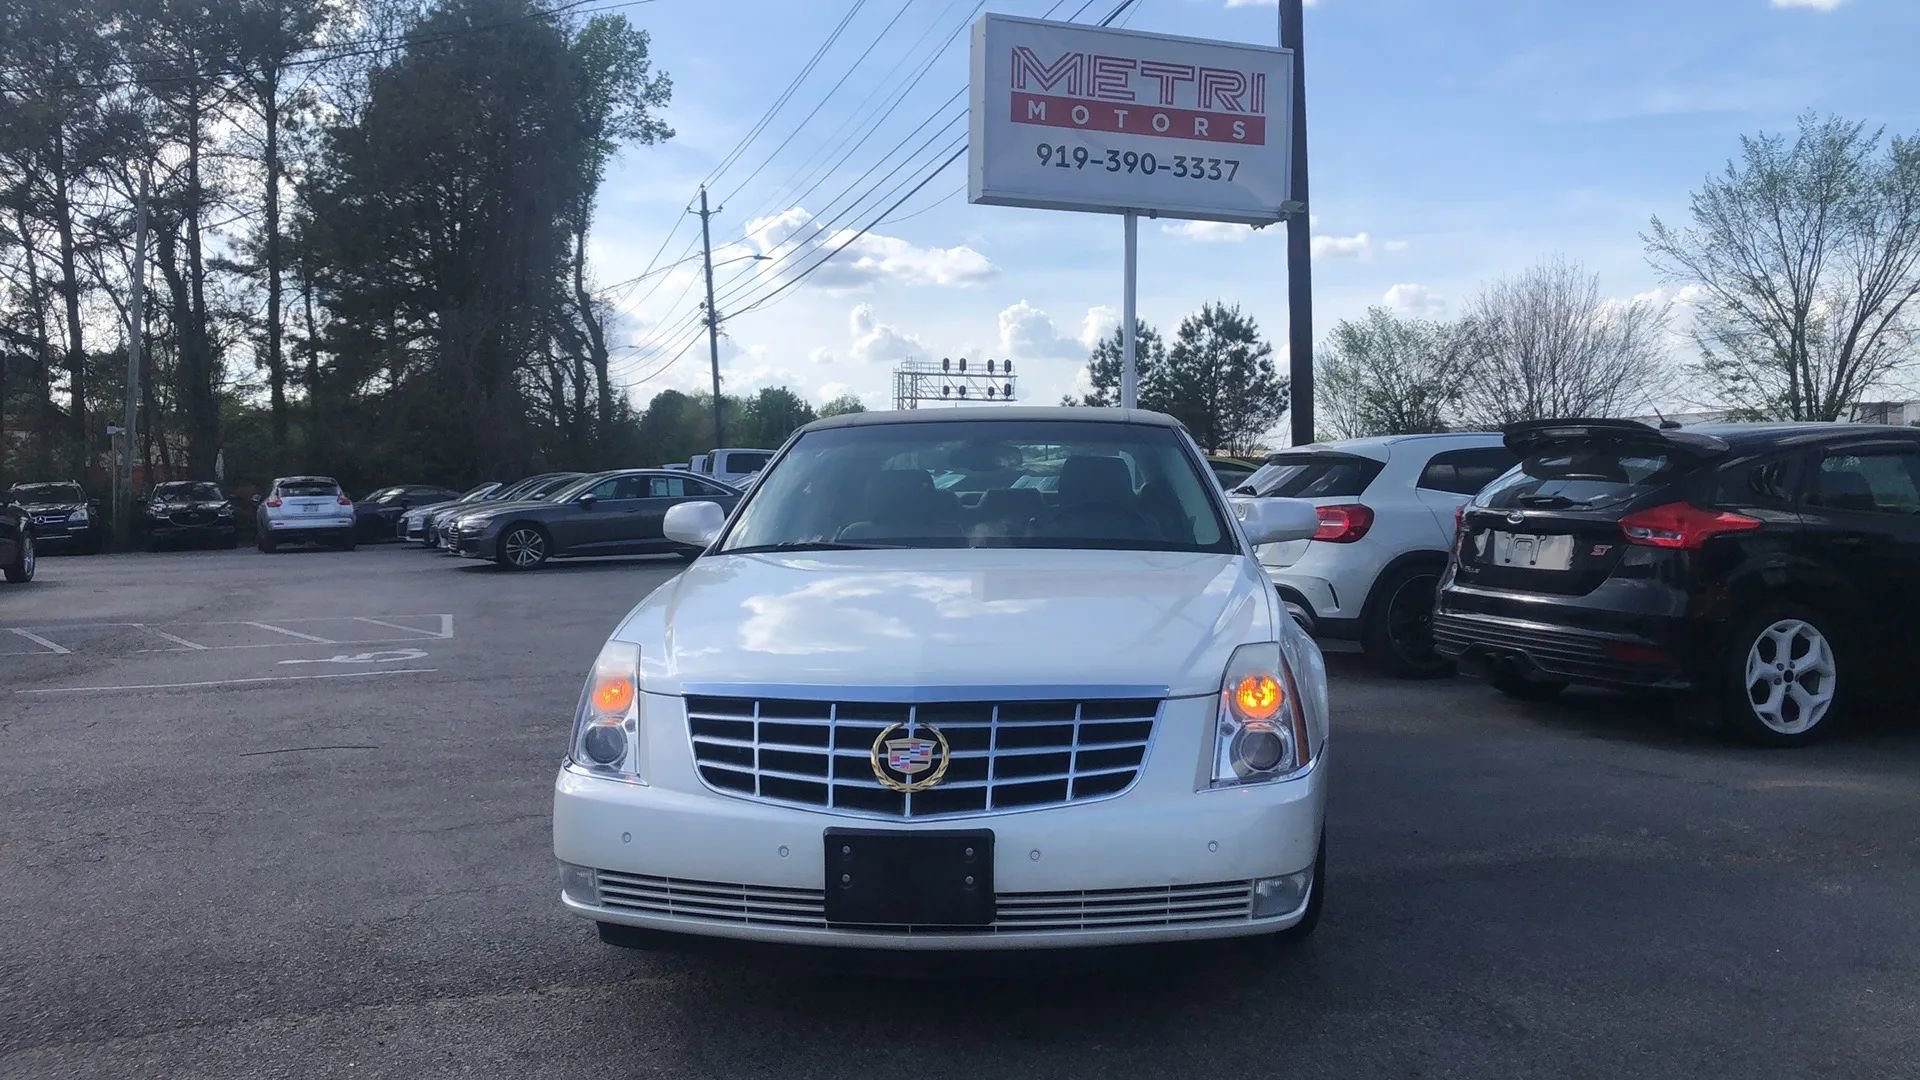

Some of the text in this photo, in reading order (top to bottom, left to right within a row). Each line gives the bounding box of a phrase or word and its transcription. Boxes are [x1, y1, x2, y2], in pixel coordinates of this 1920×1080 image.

[1011, 47, 1265, 113] METRI
[1027, 100, 1246, 140] MOTORS
[1036, 143, 1240, 182] 919-390-3337
